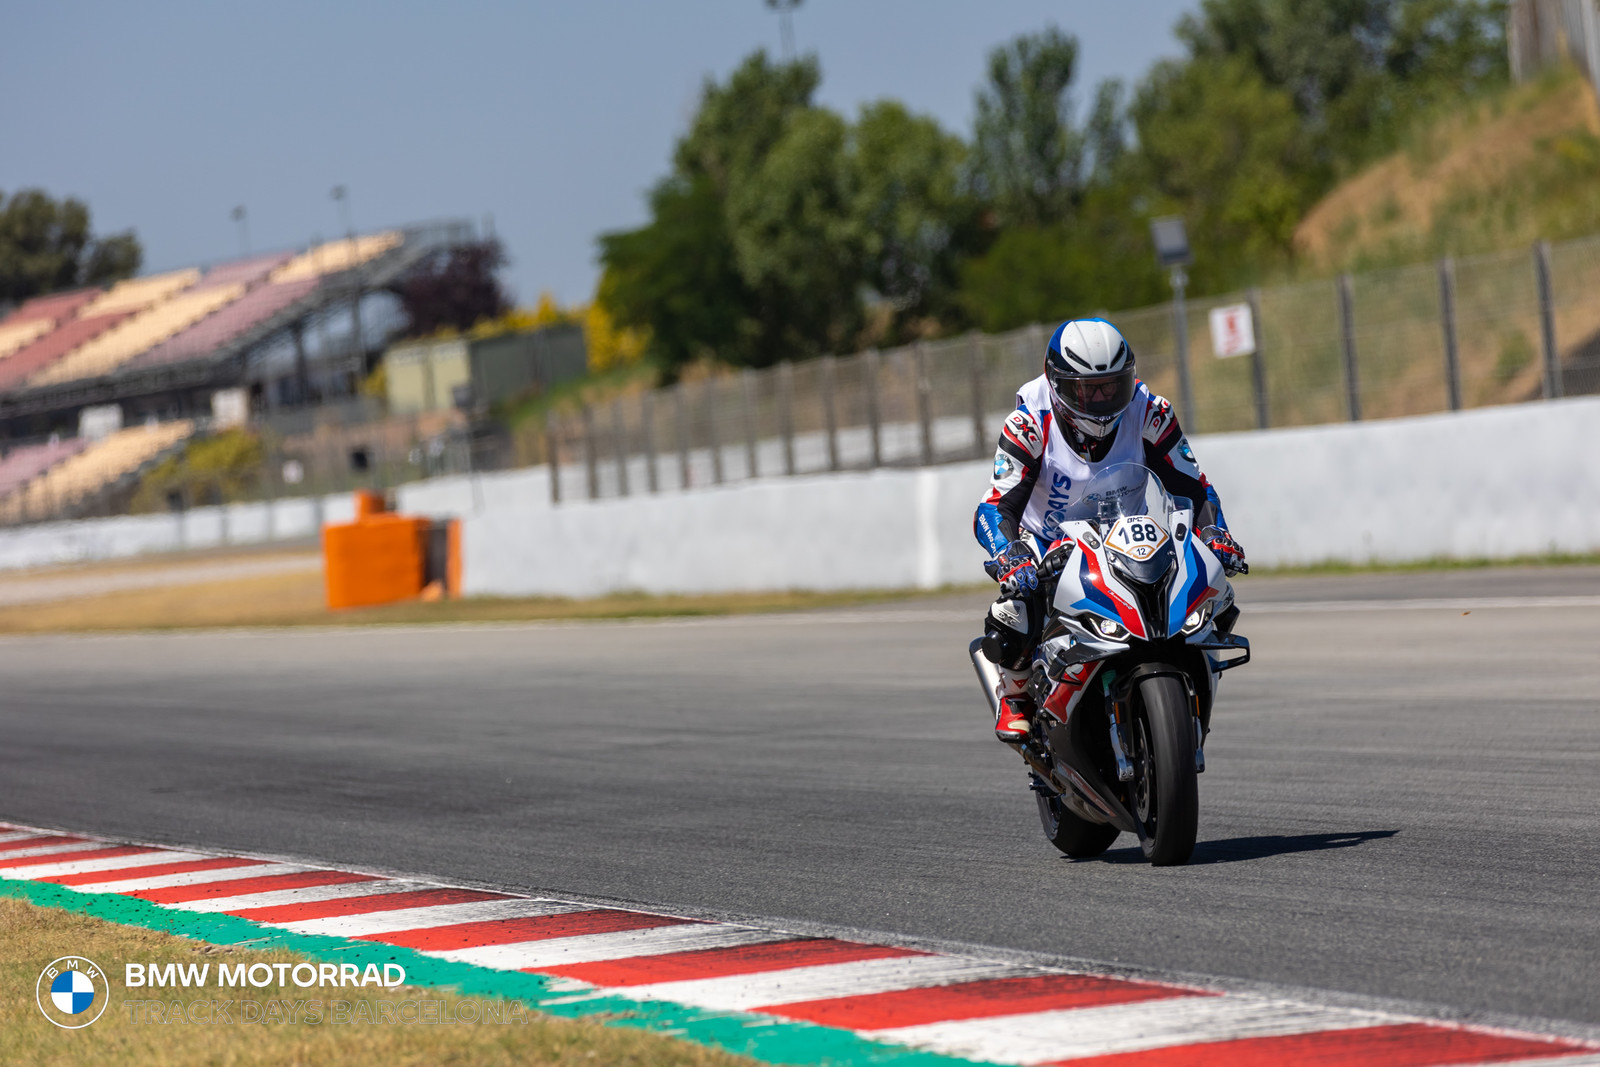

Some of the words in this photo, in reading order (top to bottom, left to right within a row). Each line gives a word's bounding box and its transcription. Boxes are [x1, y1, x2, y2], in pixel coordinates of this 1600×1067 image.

[978, 513, 990, 532] BMW
[1118, 523, 1158, 545] 188
[1136, 547, 1147, 556] 12
